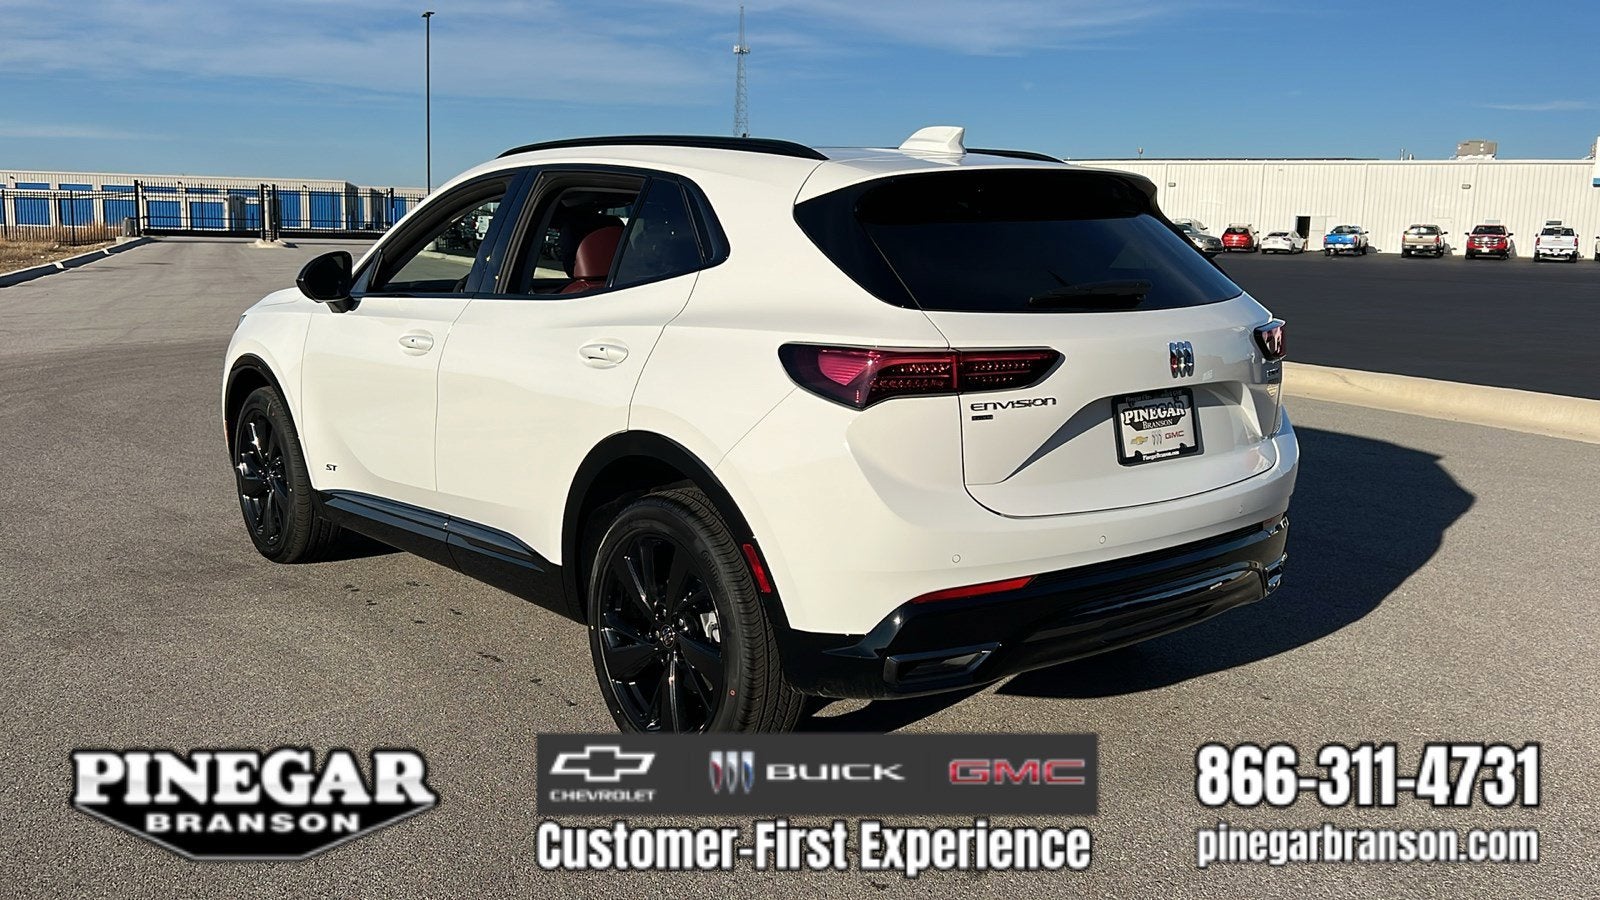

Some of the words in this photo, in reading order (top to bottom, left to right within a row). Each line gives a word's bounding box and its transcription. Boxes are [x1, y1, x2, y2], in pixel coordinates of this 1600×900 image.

[970, 397, 1057, 412] ENVISION
[1123, 401, 1185, 424] PINEGAR
[1142, 419, 1173, 430] BRANSON
[1164, 430, 1184, 440] GMC
[325, 463, 338, 472] ST
